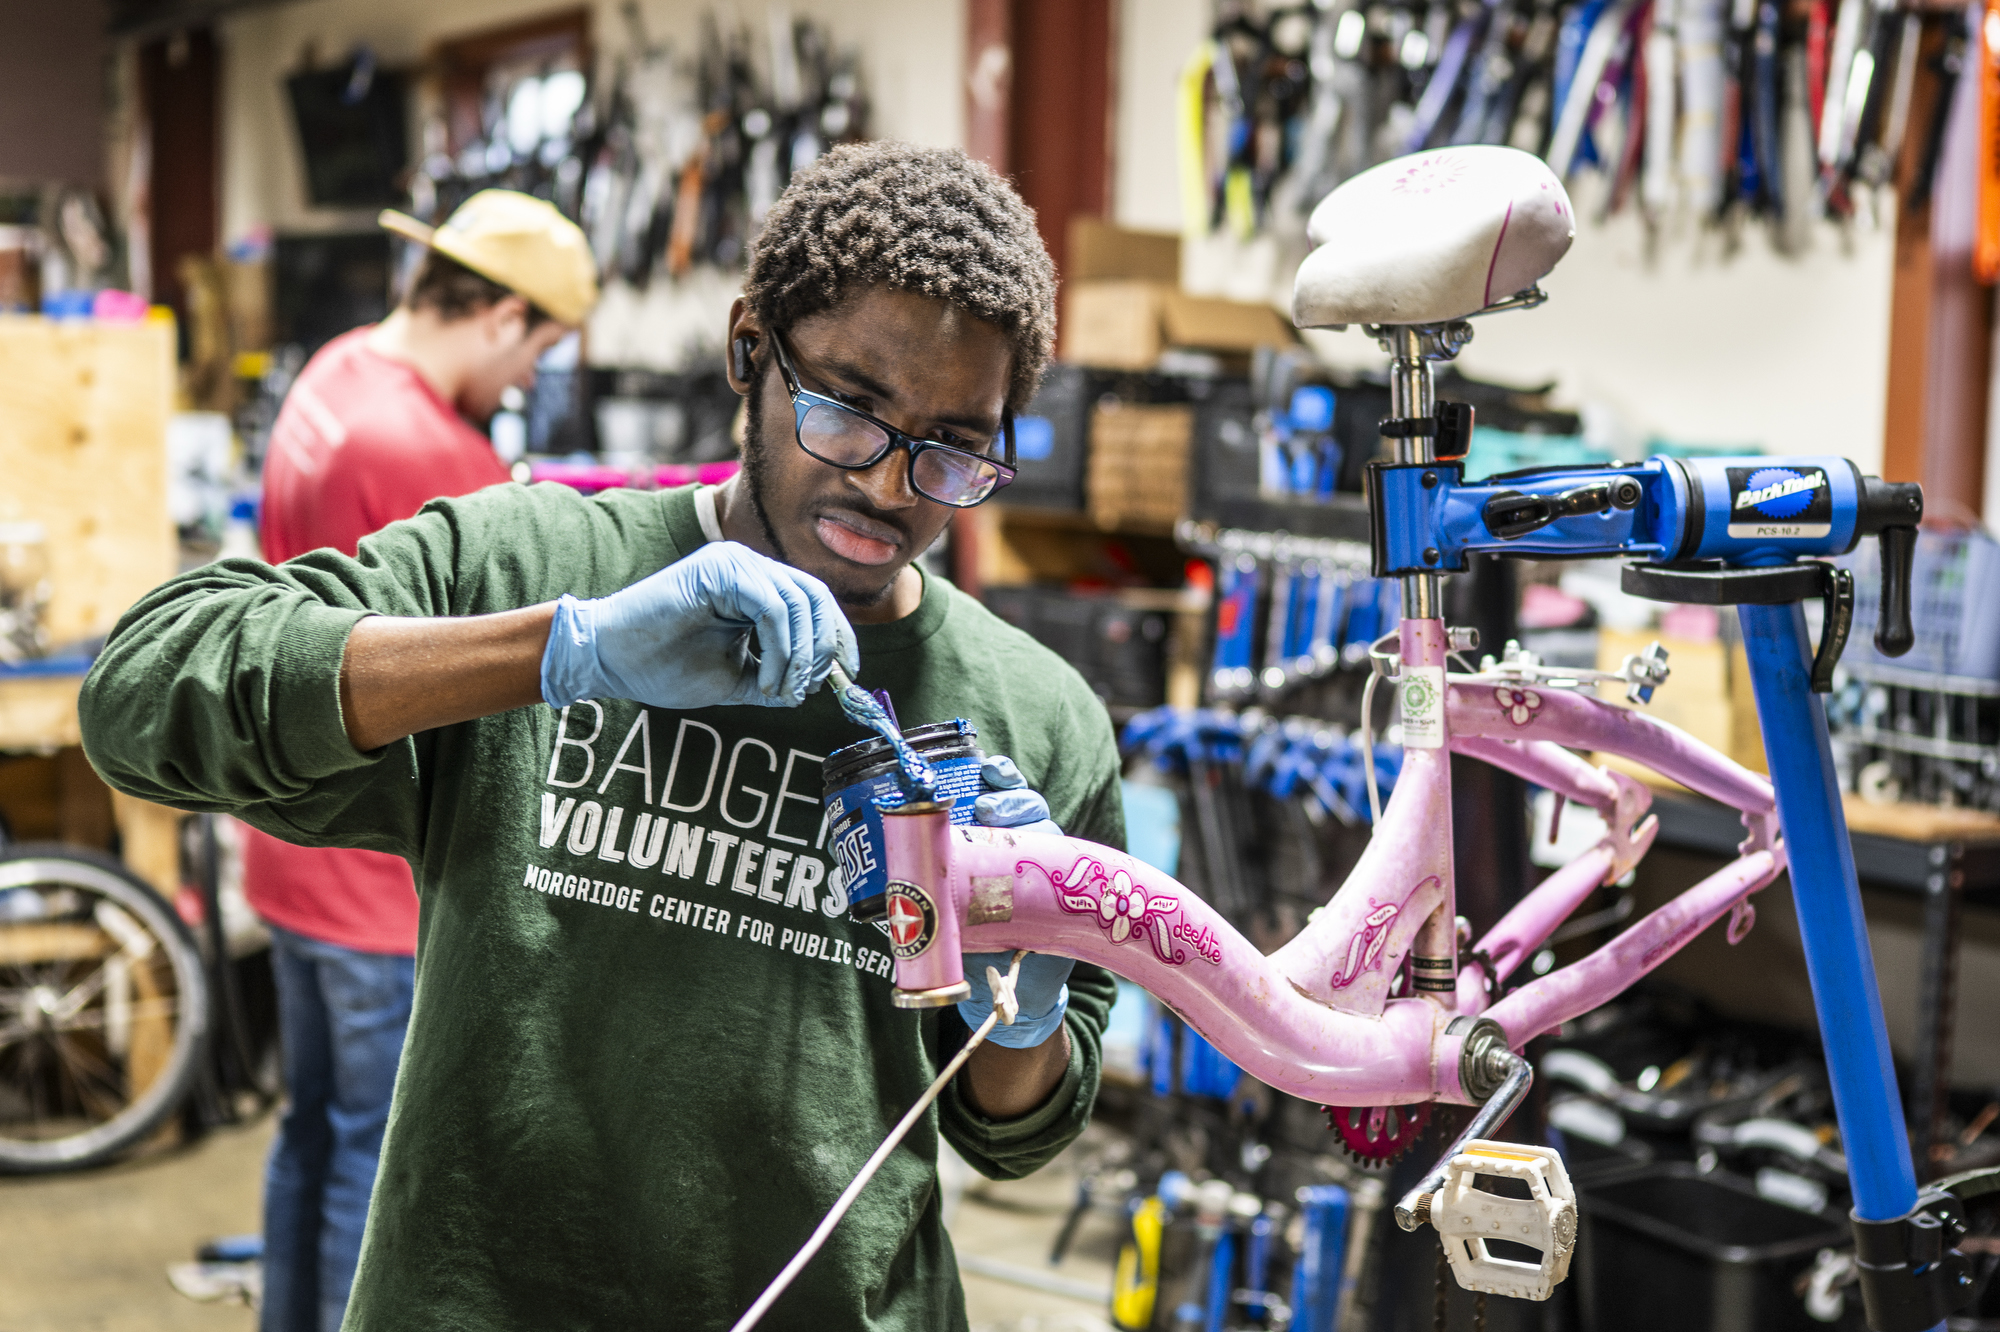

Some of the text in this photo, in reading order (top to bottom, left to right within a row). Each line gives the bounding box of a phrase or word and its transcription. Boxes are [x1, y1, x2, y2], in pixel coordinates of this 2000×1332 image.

[1757, 527, 1800, 536] PCS-10.2
[546, 699, 830, 850] BADGE
[539, 792, 849, 918] VOLUNTEERS
[832, 816, 852, 840] PROOF
[836, 823, 877, 891] ASE
[523, 863, 898, 983] MORGRIDGE CENTER FOR PUBLIC SER
[893, 932, 929, 957] ALITY
[1172, 910, 1222, 964] deelite
